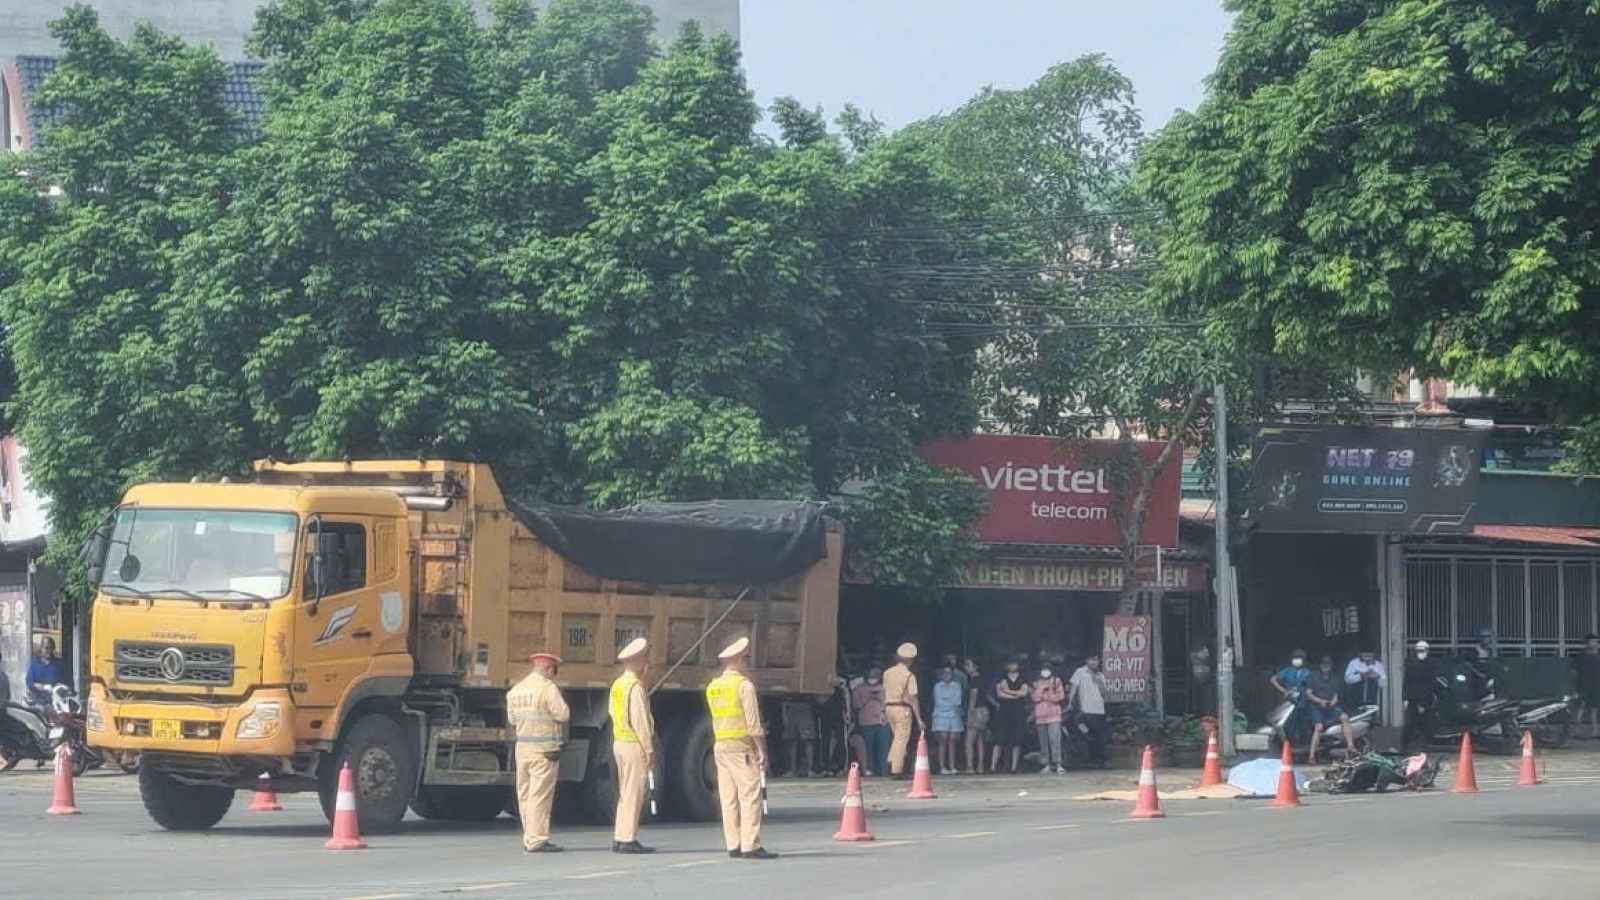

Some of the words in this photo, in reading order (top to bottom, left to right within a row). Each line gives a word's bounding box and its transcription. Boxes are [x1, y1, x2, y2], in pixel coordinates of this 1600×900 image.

[1327, 448, 1375, 468] NET
[980, 461, 1110, 494] viettel
[1322, 474, 1357, 485] GAME
[1364, 475, 1411, 487] ONLINE
[1031, 501, 1108, 520] telecom
